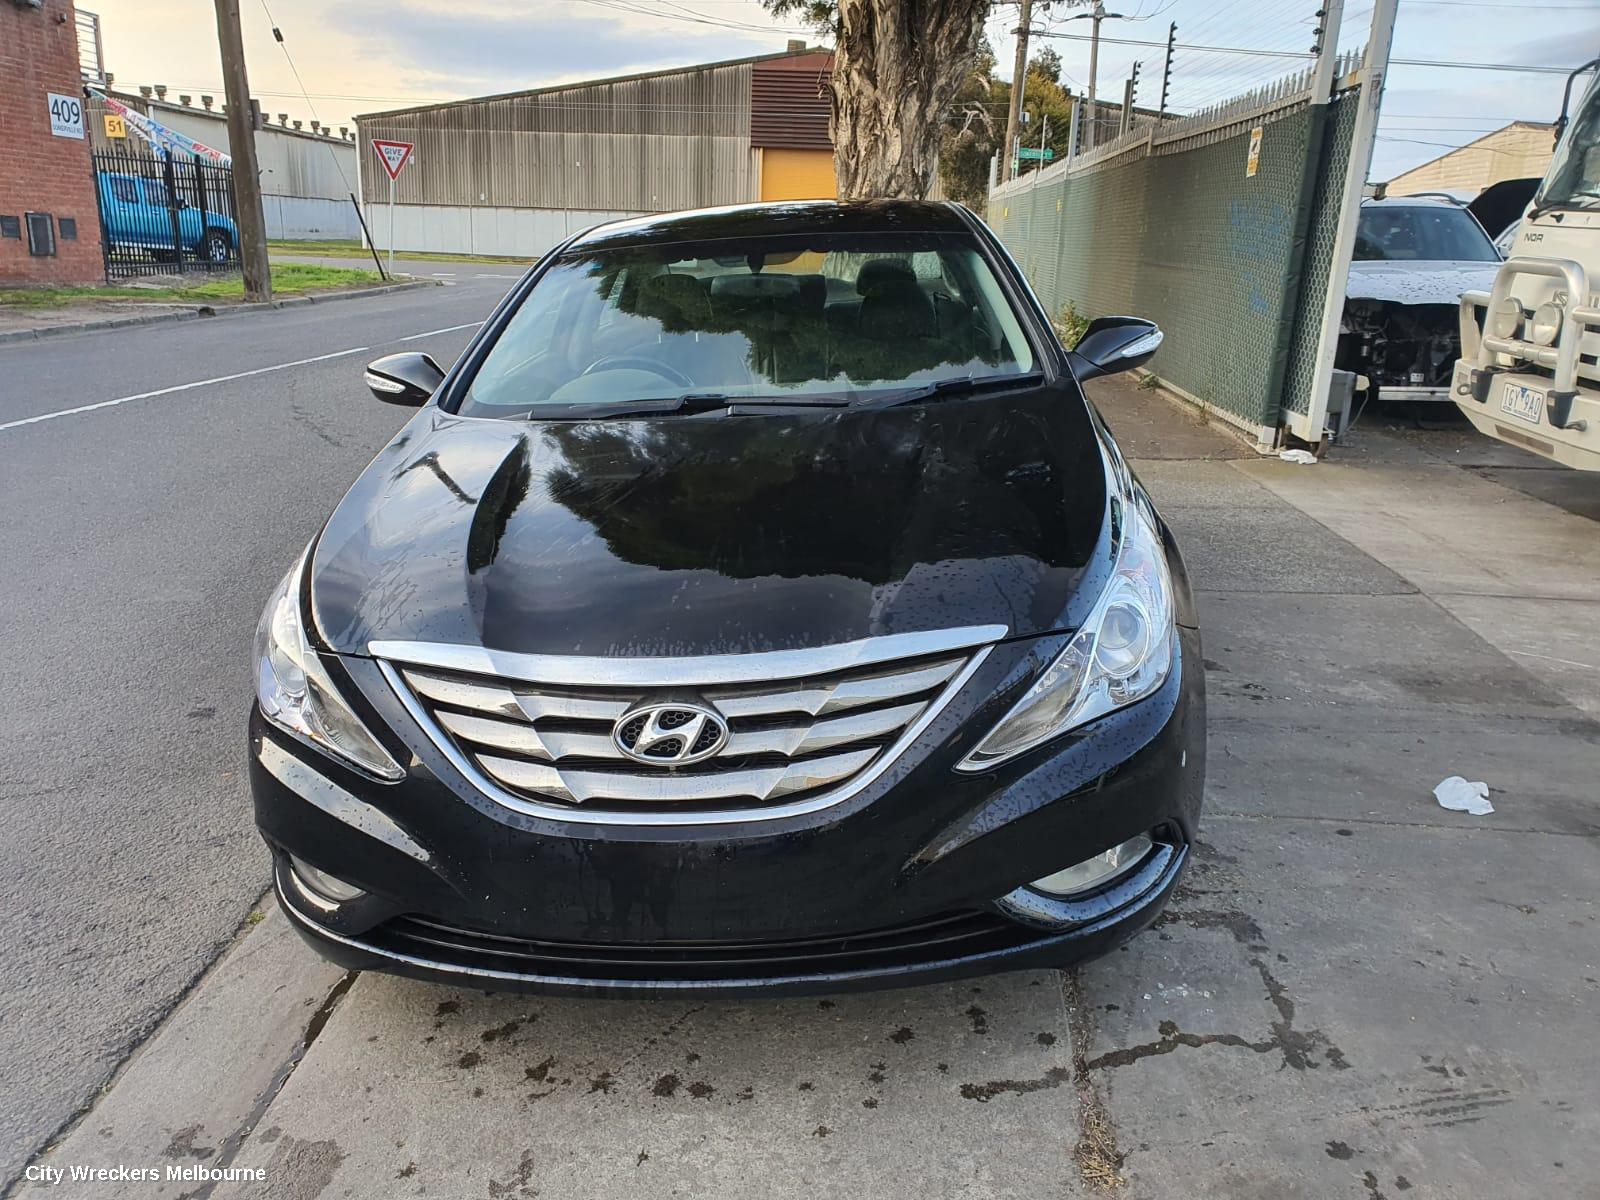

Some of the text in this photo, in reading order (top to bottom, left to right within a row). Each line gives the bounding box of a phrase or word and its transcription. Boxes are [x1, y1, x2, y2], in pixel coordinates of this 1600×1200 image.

[52, 99, 80, 124] 409
[108, 120, 122, 133] 51
[385, 147, 403, 156] GIVE
